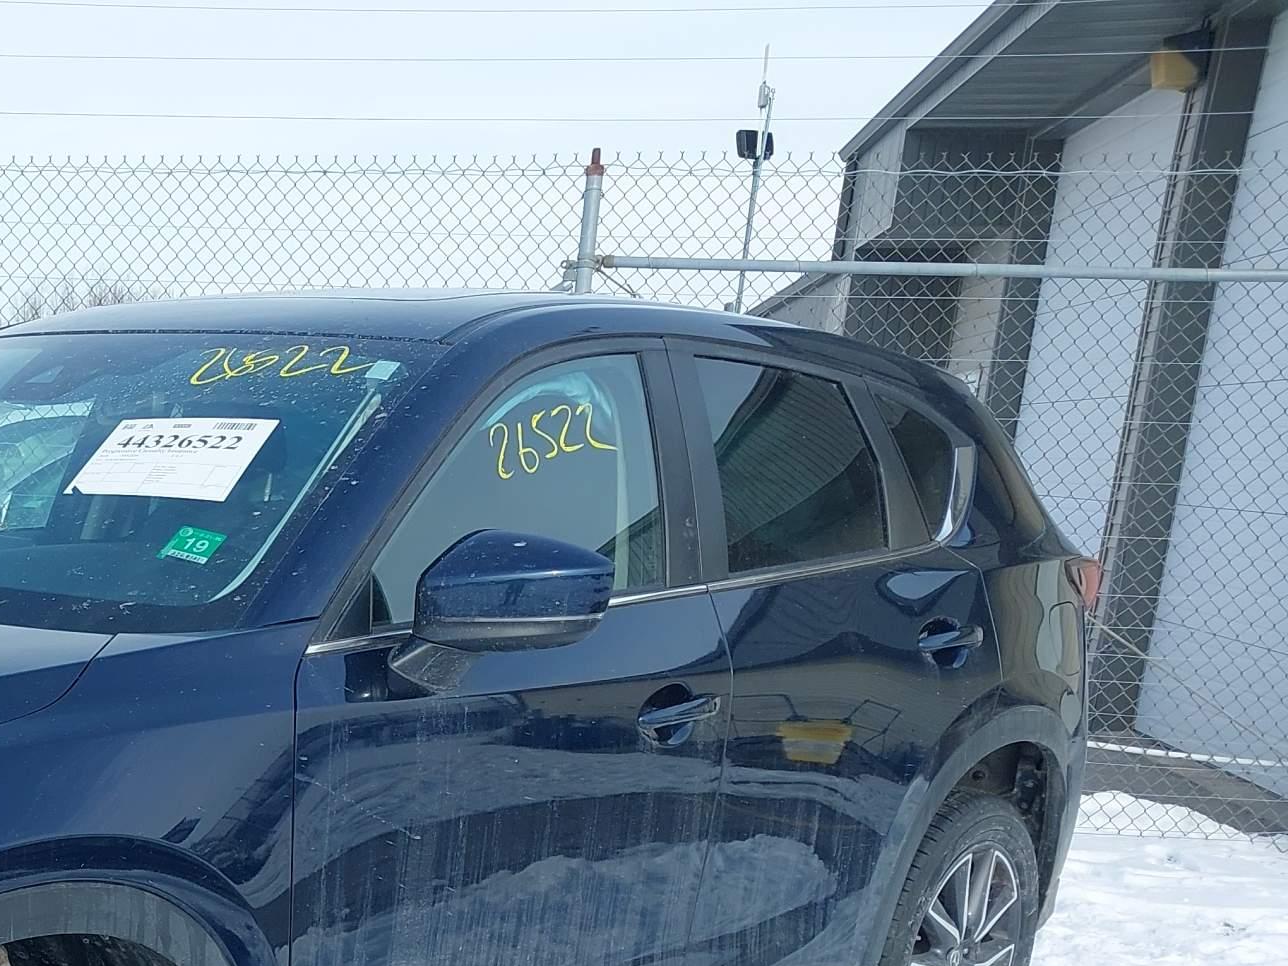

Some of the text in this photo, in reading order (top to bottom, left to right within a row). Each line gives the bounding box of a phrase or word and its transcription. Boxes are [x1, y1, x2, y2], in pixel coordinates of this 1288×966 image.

[117, 434, 243, 450] 44326522
[489, 402, 618, 479] 26522
[184, 538, 210, 552] 19
